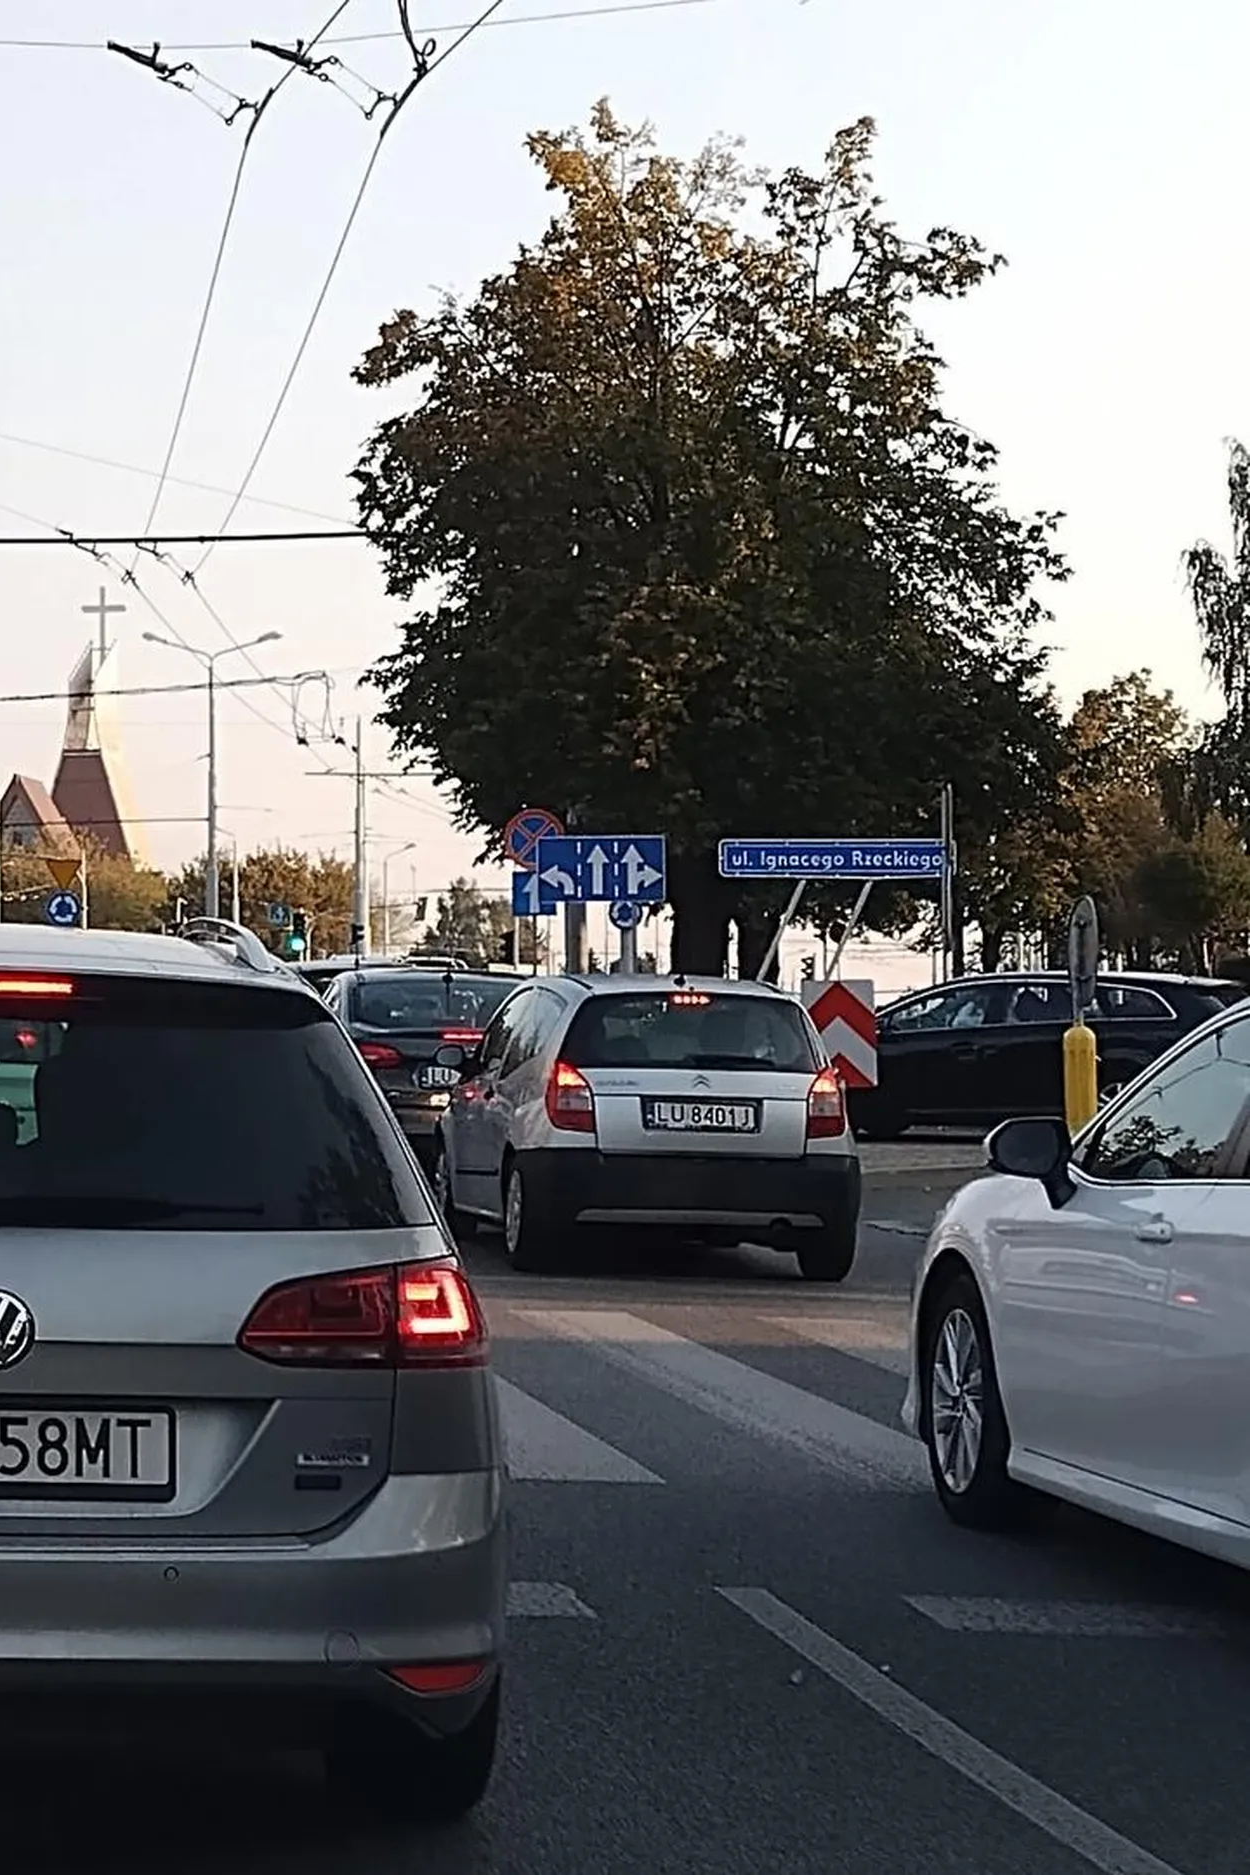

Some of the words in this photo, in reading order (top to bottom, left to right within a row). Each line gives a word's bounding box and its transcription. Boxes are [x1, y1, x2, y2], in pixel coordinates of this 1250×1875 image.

[731, 850, 753, 867] ul.
[760, 850, 845, 871] Ignacego
[851, 850, 943, 870] Rzeckiego
[656, 1103, 685, 1123] LU
[690, 1105, 750, 1128] 8401J
